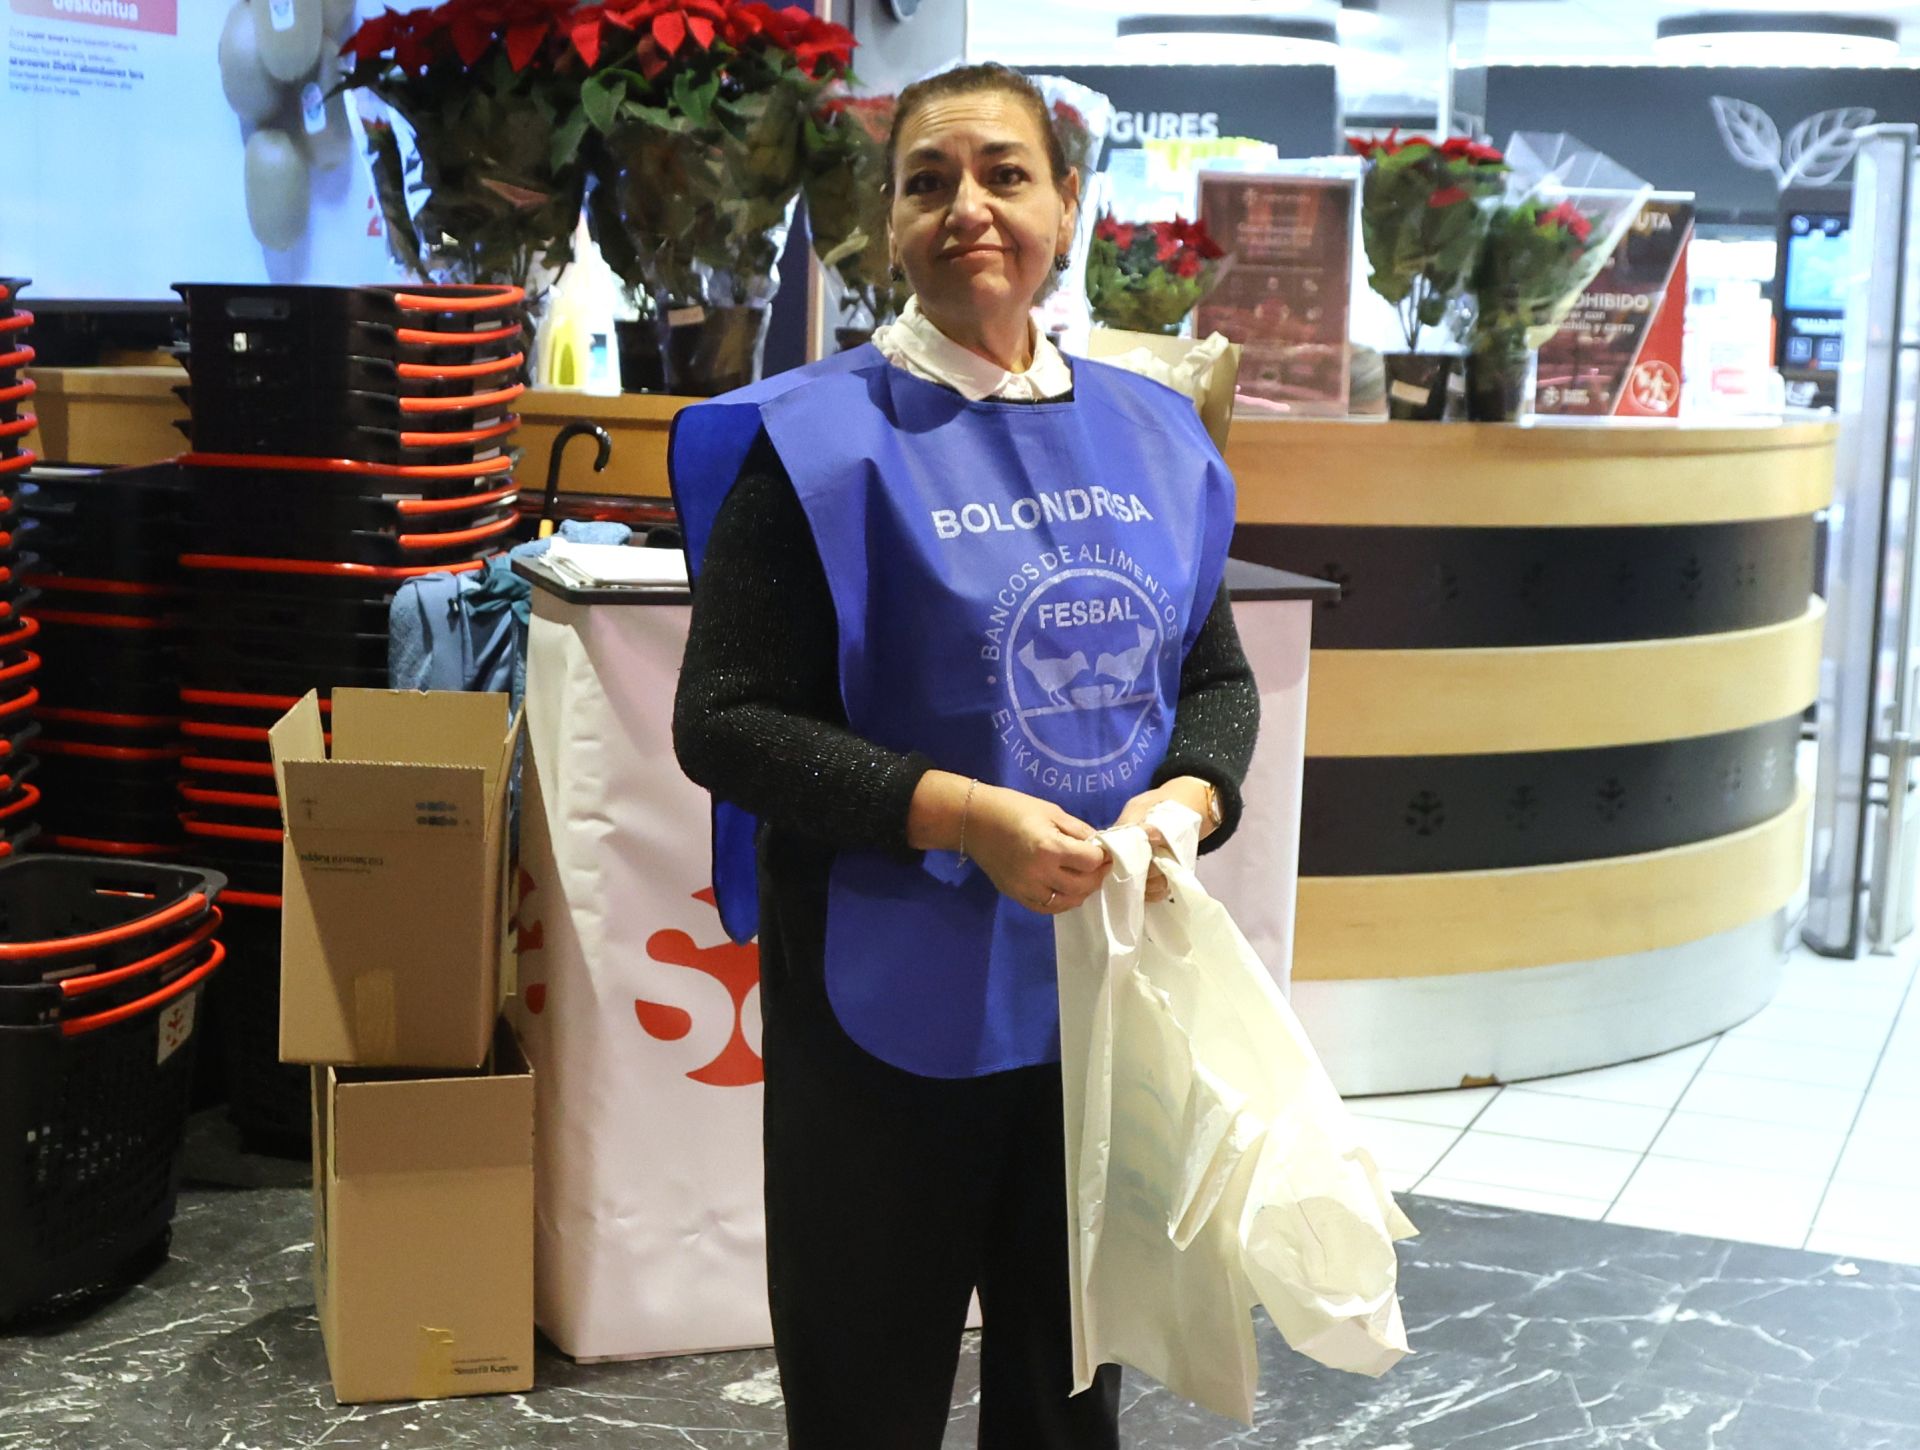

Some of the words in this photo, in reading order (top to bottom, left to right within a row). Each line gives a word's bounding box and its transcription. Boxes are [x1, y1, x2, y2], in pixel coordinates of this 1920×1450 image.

[982, 562, 1041, 661] BANCOS
[1039, 545, 1075, 571] DE
[1079, 544, 1178, 641] ALIMENTOS
[1038, 596, 1141, 629] FESBAL
[991, 708, 1115, 793] ELIKAGAIEN
